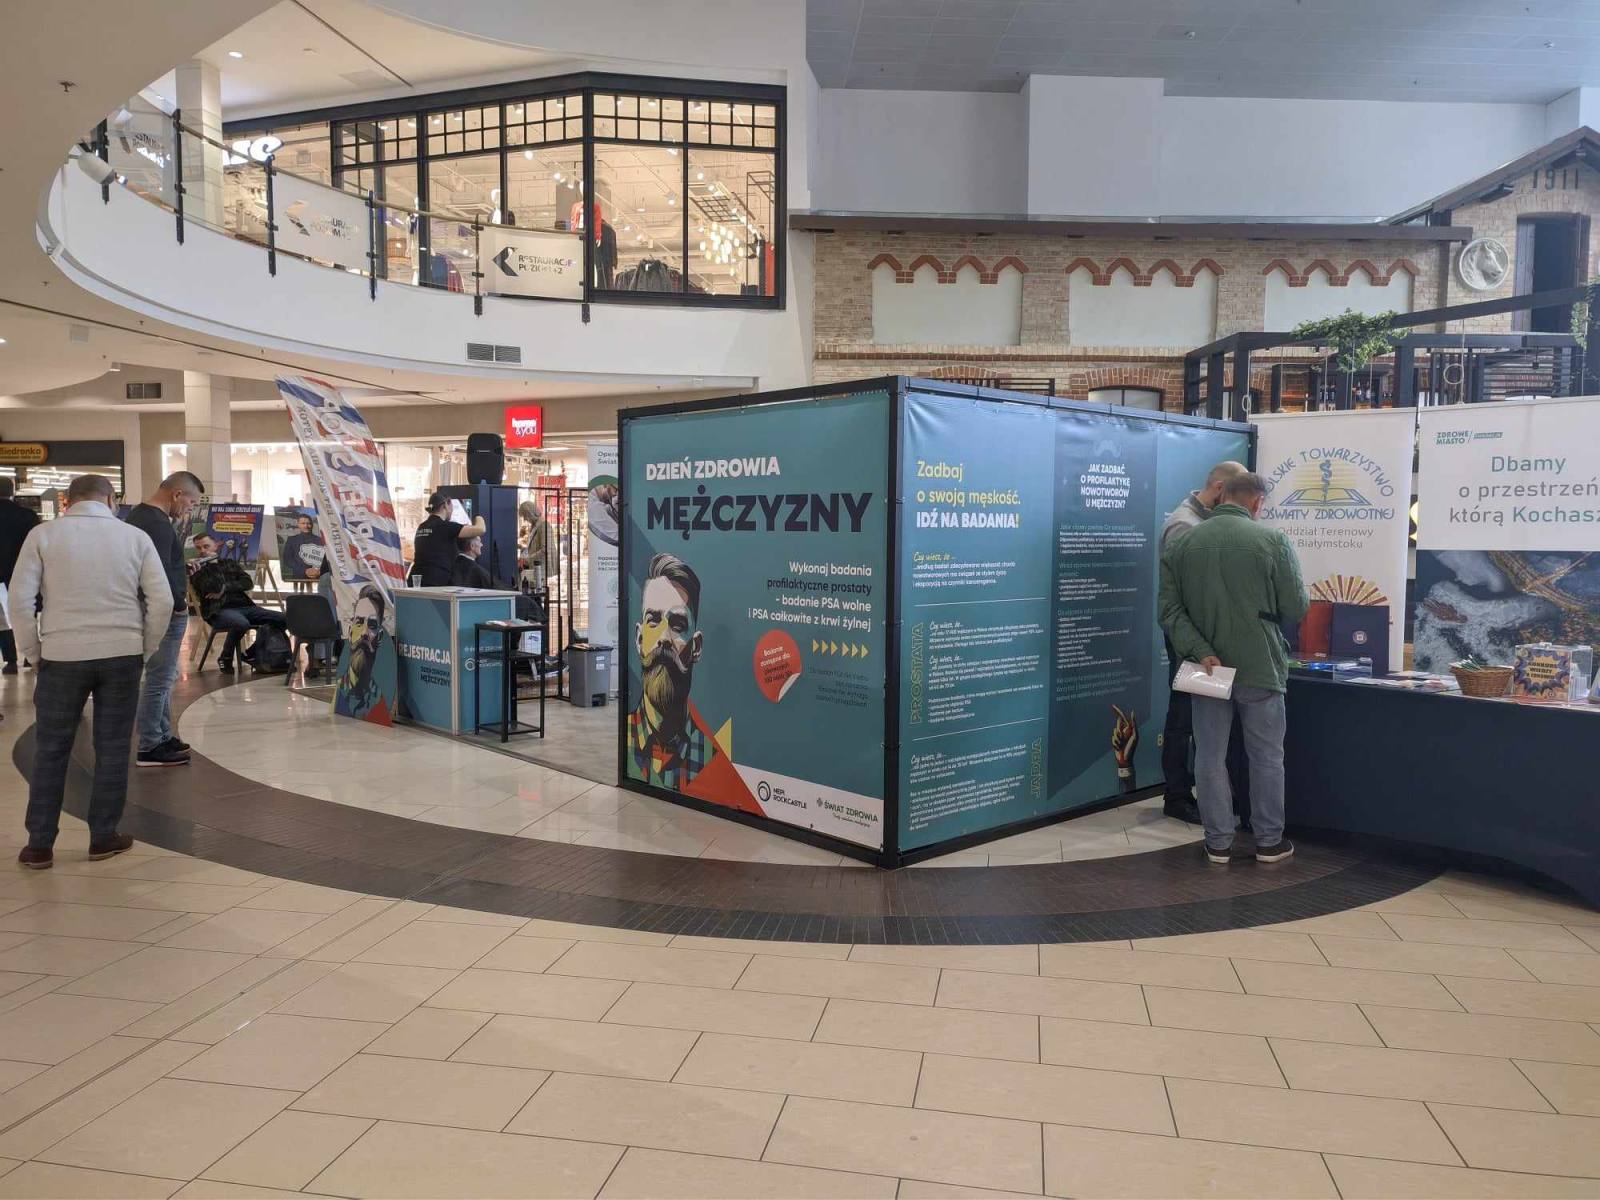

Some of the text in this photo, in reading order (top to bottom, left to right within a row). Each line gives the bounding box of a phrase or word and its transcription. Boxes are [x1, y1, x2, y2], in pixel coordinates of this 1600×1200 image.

[1533, 168, 1579, 190] 1911
[1436, 437, 1466, 445] MIASTO
[1437, 430, 1469, 439] ZDROWE
[646, 456, 780, 480] DZIEŃ ZDROWIA
[917, 460, 963, 482] Zadbaj
[1088, 464, 1125, 474] JAK ZADBAĆ
[1265, 447, 1394, 497] OLSKIE TOWARZYSTWO
[1491, 455, 1567, 475] Dbamy
[1080, 474, 1086, 484] O
[1459, 476, 1599, 502] o przestrzeń
[917, 487, 1021, 508] o swoją męskość.
[1081, 486, 1130, 497] NOWOTWORÓW
[647, 484, 873, 540] MĘŻCZYZNY
[1086, 499, 1090, 507] U
[916, 507, 1019, 529] IDŹ NA BADANIA!
[1315, 508, 1395, 520] ZDROWOTNEJ
[1450, 505, 1504, 527] którą
[1320, 527, 1374, 537] Terenowy
[1297, 539, 1363, 549] Białymstoku
[789, 561, 872, 577] Wykonaj badania
[767, 577, 872, 596] profilaktyczne prostaty
[782, 595, 819, 608] badanie
[822, 597, 840, 610] PSA
[842, 599, 872, 612] wolne
[752, 609, 769, 620] PSA
[770, 609, 812, 624] całkowite
[814, 616, 819, 625] z
[821, 614, 840, 627] krwi
[842, 616, 871, 632] żylnej
[398, 643, 451, 665] REJESTRACJA
[910, 622, 924, 725] PROSTATA
[773, 794, 807, 809] ROCKCASTLE
[824, 799, 844, 813] ŚWIAT
[846, 807, 878, 822] ZDROWIA
